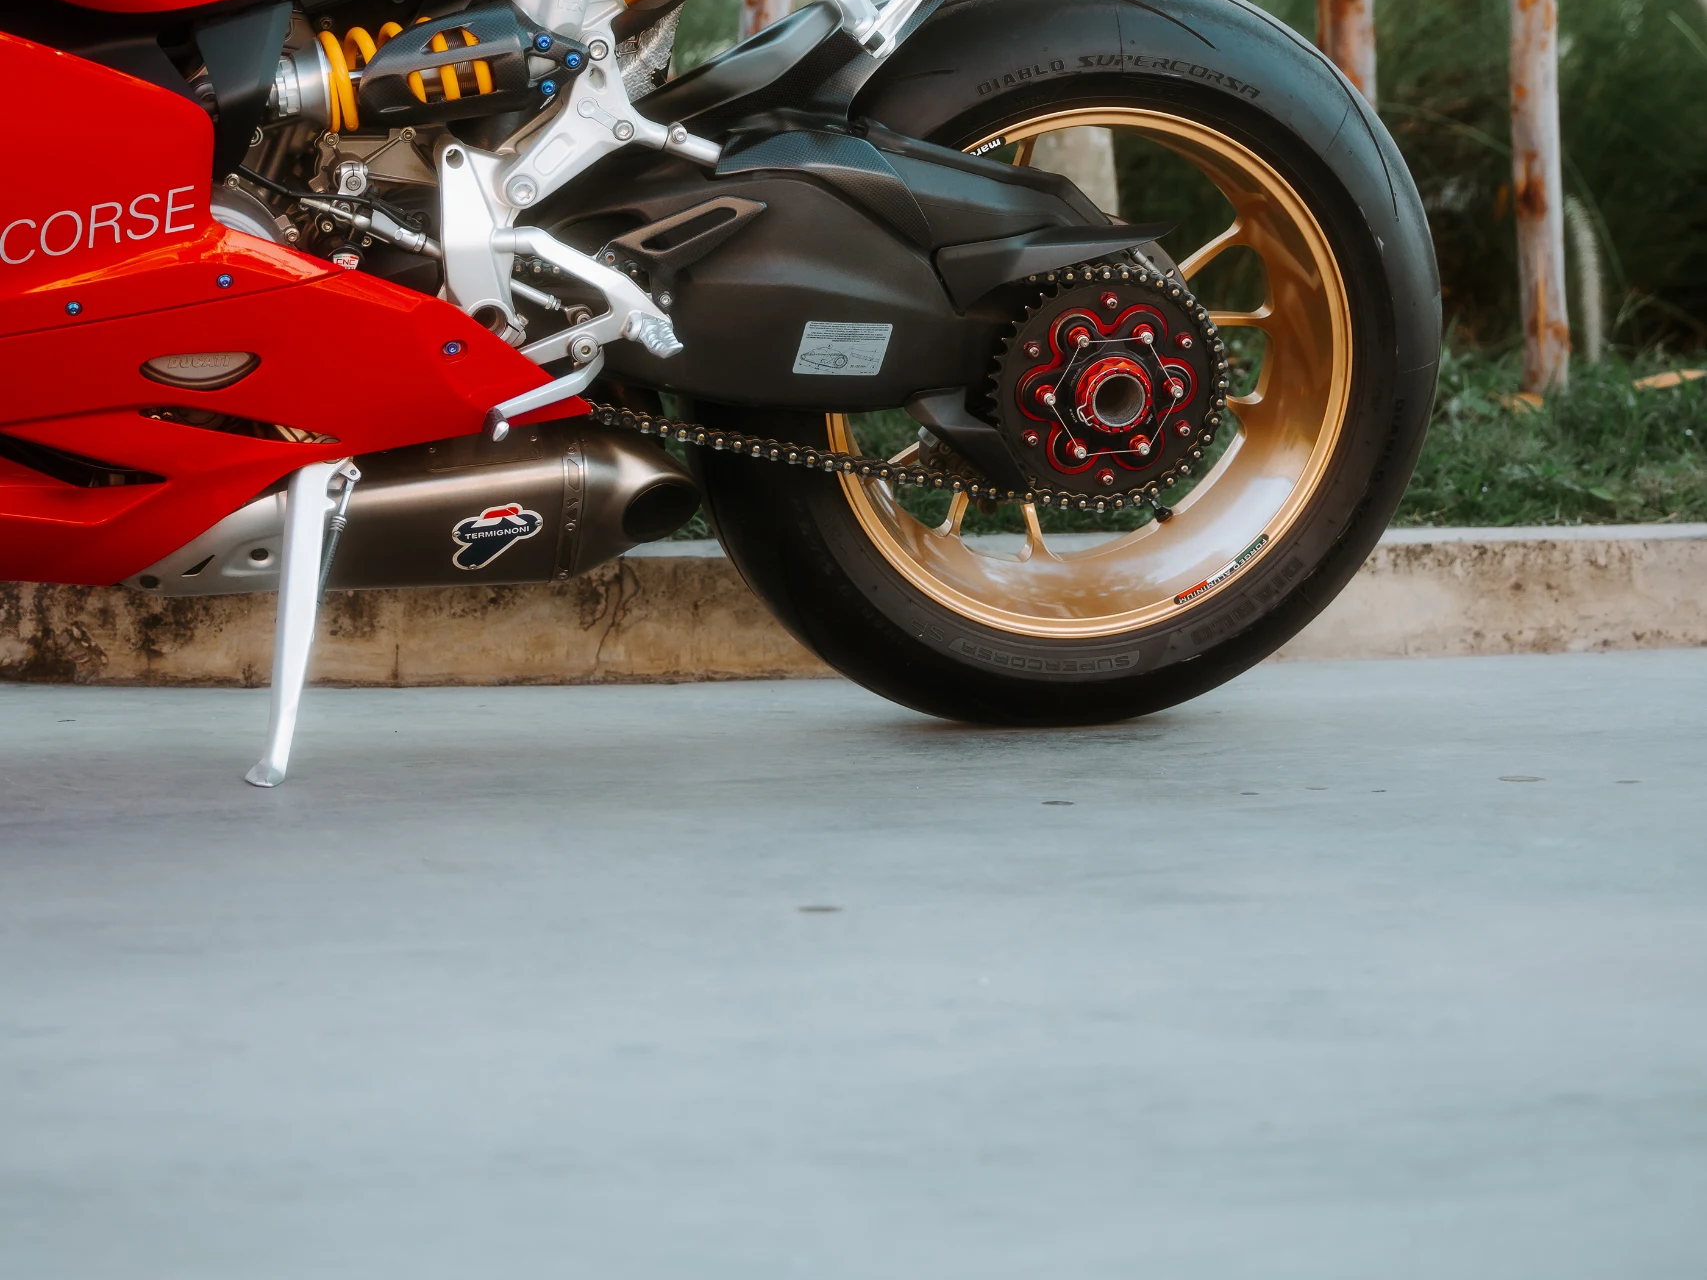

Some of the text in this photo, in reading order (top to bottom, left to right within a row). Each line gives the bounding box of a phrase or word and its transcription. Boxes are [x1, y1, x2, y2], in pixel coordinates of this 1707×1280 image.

[976, 58, 1066, 98] DIABLO
[1077, 53, 1261, 100] SUPERCORSA
[0, 185, 195, 265] CORSE
[167, 354, 231, 369] DUCATI
[464, 525, 531, 540] TERMIGNONI
[1178, 538, 1268, 604] FORGED ALUMINIUM
[910, 556, 1307, 672] DIABLO SUPERCORSA SP
